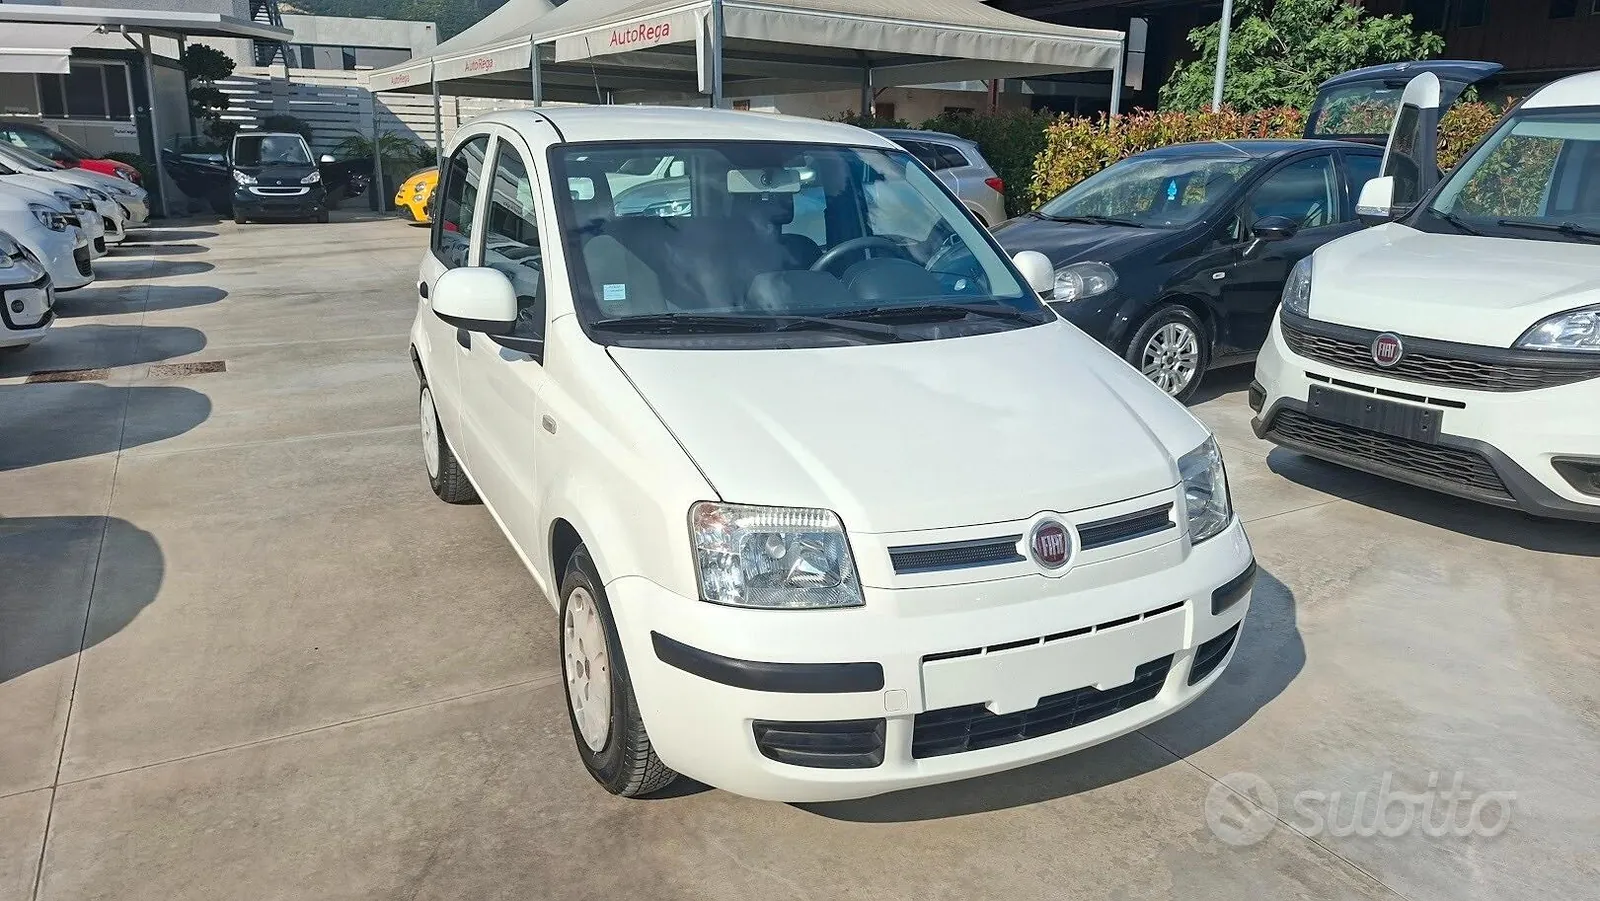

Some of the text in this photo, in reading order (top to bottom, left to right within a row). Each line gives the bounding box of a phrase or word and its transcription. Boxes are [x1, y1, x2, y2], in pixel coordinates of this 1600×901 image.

[610, 23, 670, 47] AutoRega
[464, 58, 493, 73] AutoRega
[1377, 341, 1397, 358] FIAT
[1040, 533, 1064, 557] FIAT
